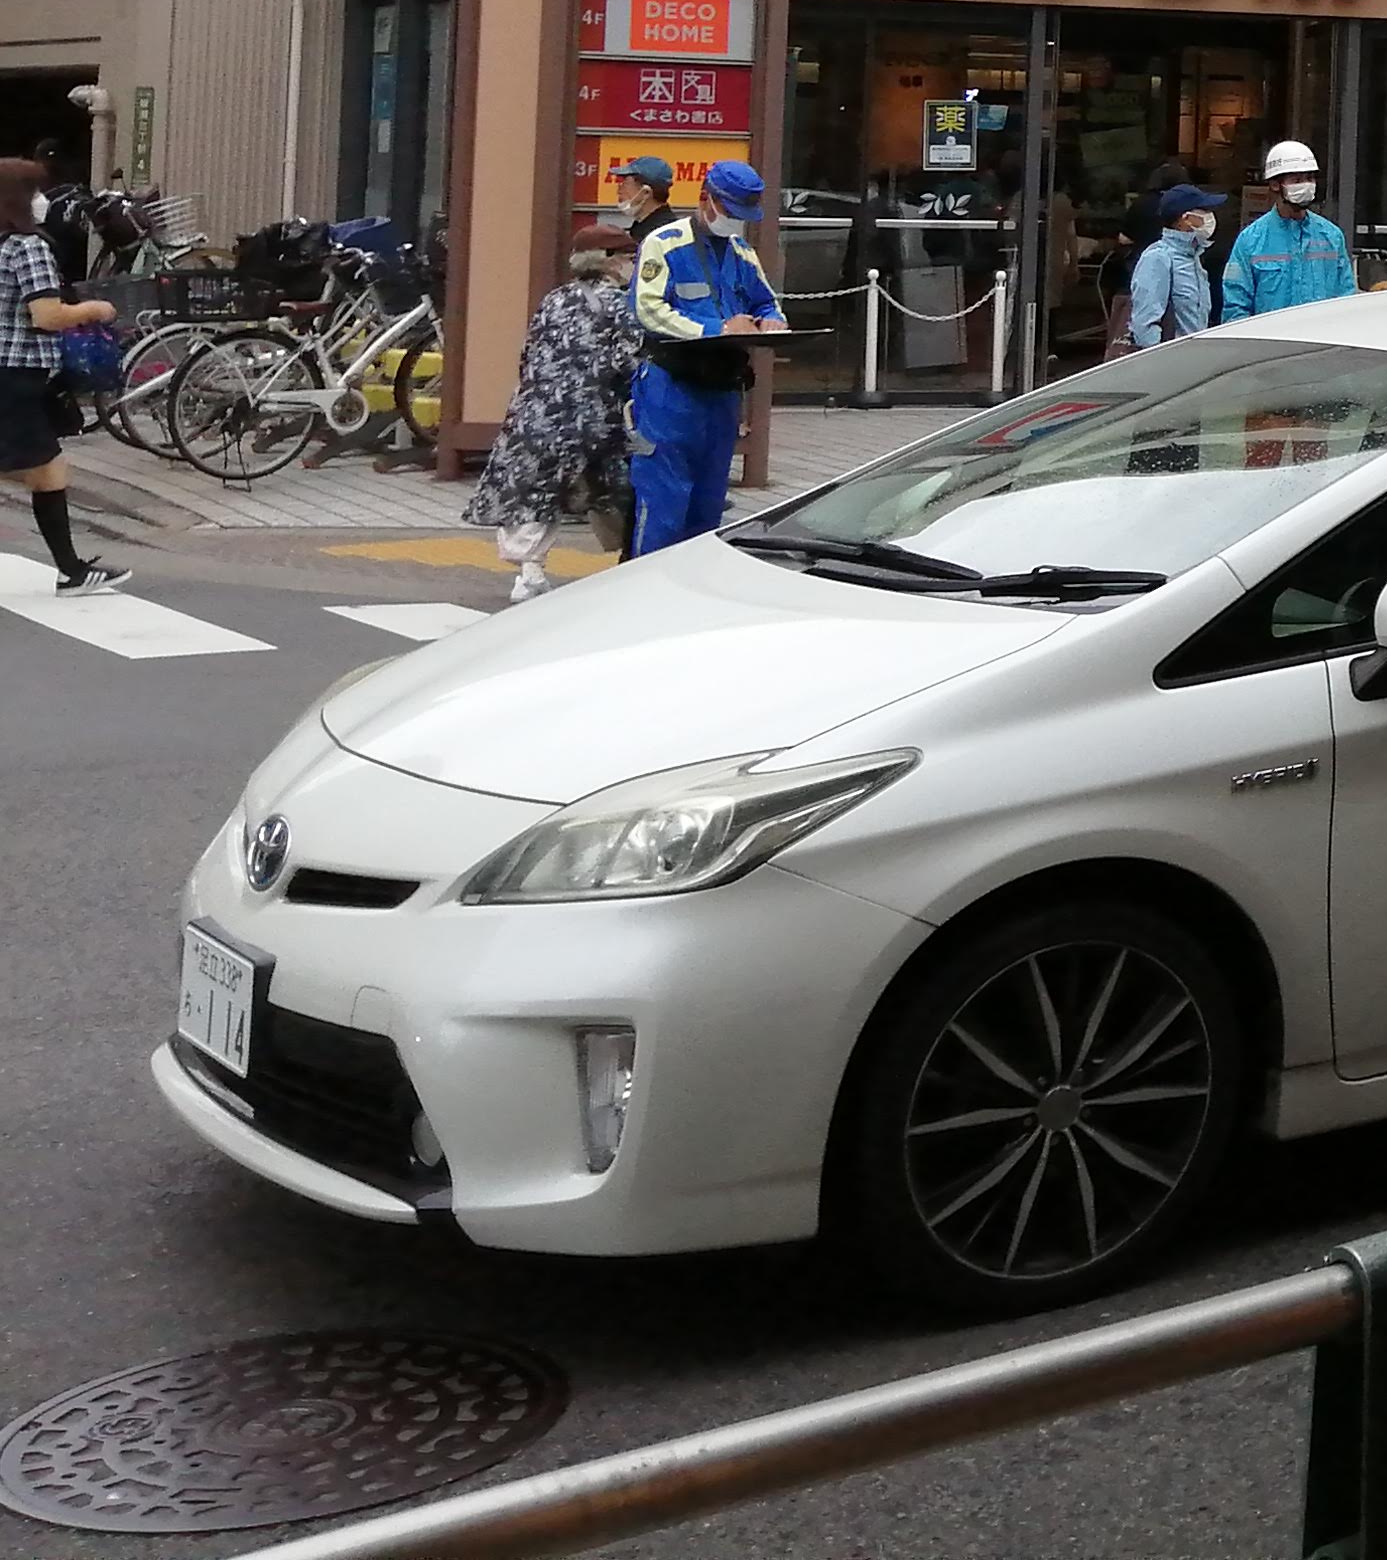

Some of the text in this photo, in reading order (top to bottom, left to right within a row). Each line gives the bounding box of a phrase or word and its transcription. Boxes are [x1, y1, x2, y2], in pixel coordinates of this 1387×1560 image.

[582, 10, 603, 25] 4F
[645, 1, 717, 22] DECO
[644, 24, 714, 44] HOME
[579, 86, 600, 101] 4F
[640, 69, 674, 103] 本
[629, 109, 723, 126] くまさわ書店
[936, 106, 966, 133] 薬
[575, 162, 597, 178] 3F
